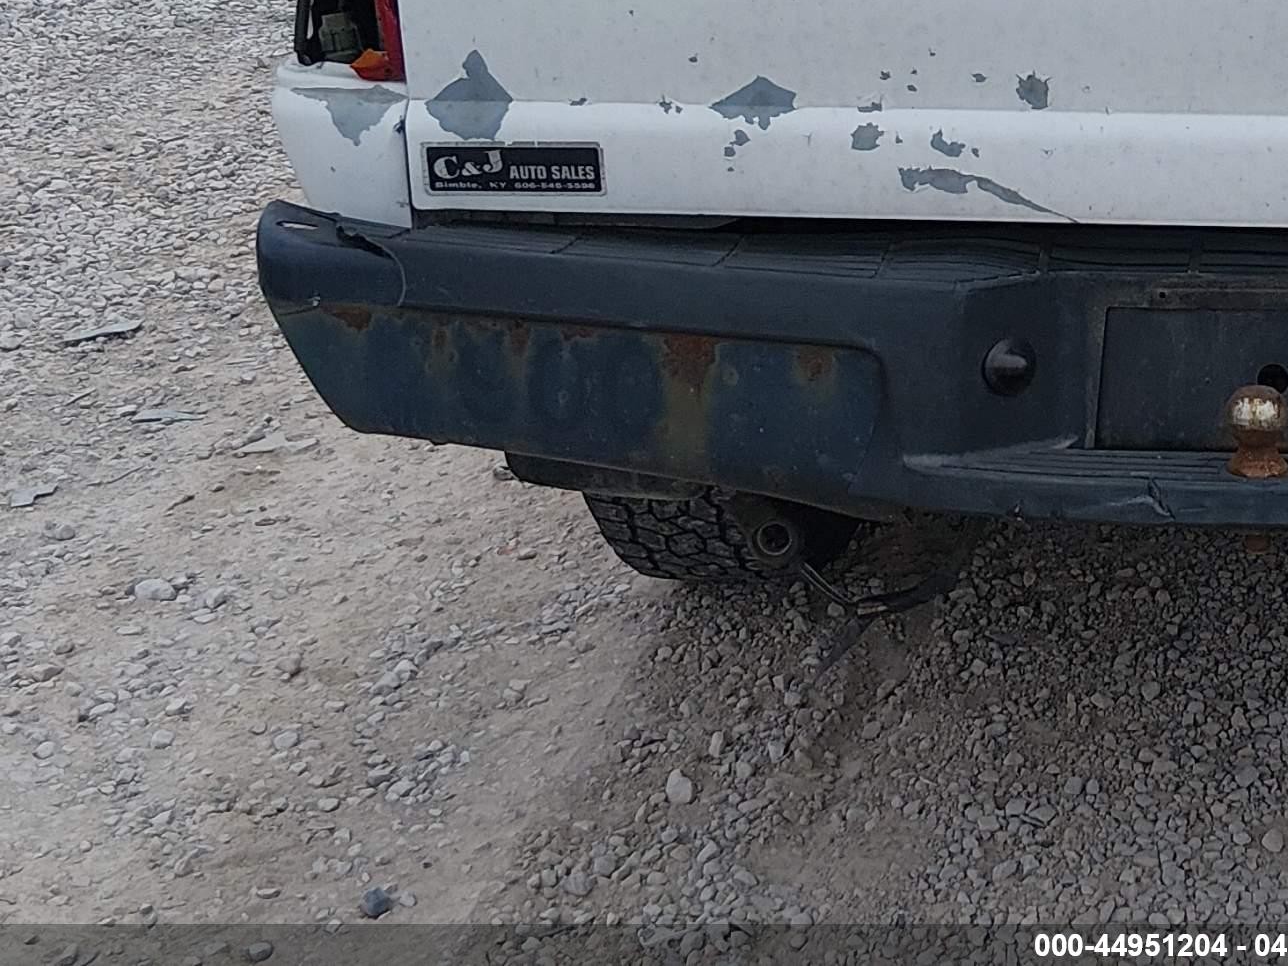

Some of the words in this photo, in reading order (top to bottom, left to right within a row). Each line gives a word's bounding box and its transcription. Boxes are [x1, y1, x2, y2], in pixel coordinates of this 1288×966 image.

[509, 165, 547, 180] AUTO
[551, 166, 595, 181] SALES
[489, 181, 507, 189] KY
